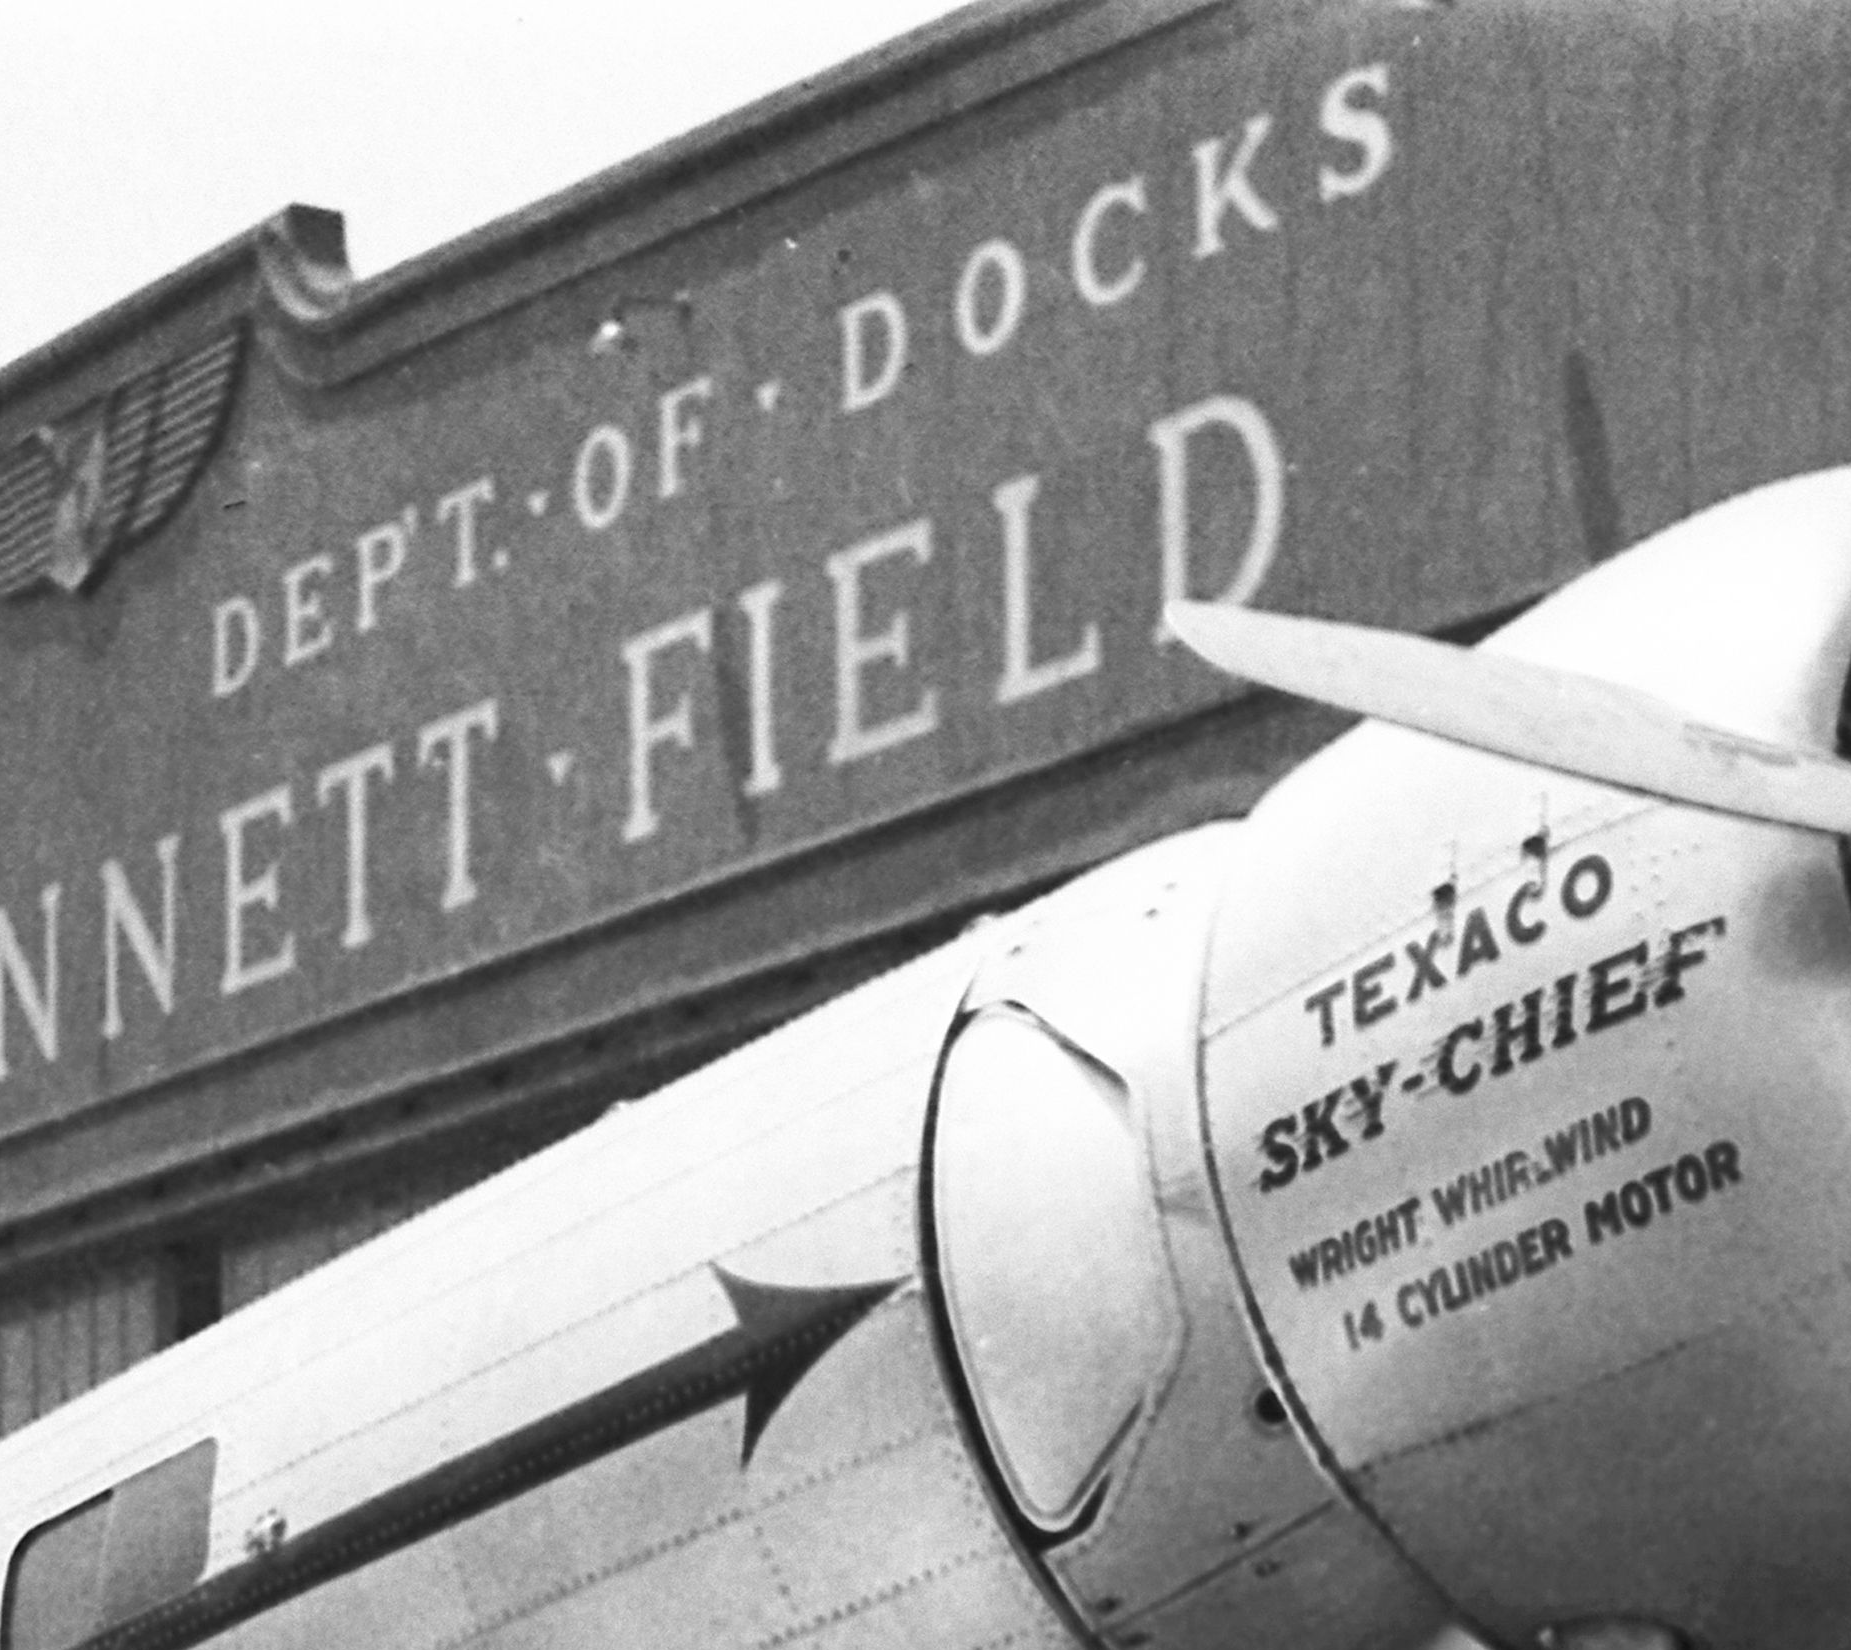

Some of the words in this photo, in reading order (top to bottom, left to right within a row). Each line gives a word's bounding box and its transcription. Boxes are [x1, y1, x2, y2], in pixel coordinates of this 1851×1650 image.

[574, 376, 711, 530] OF
[841, 63, 1393, 410] DOCKS
[623, 397, 1285, 843] FIELD
[1257, 916, 1726, 1193] SKY-CHIEF
[1305, 854, 1613, 1048] TEXACO
[1288, 1198, 1421, 1289] WRIGHT
[1344, 1301, 1384, 1350] 14
[1395, 1218, 1573, 1328] CYLINDER
[1584, 1140, 1743, 1244] MOTOR
